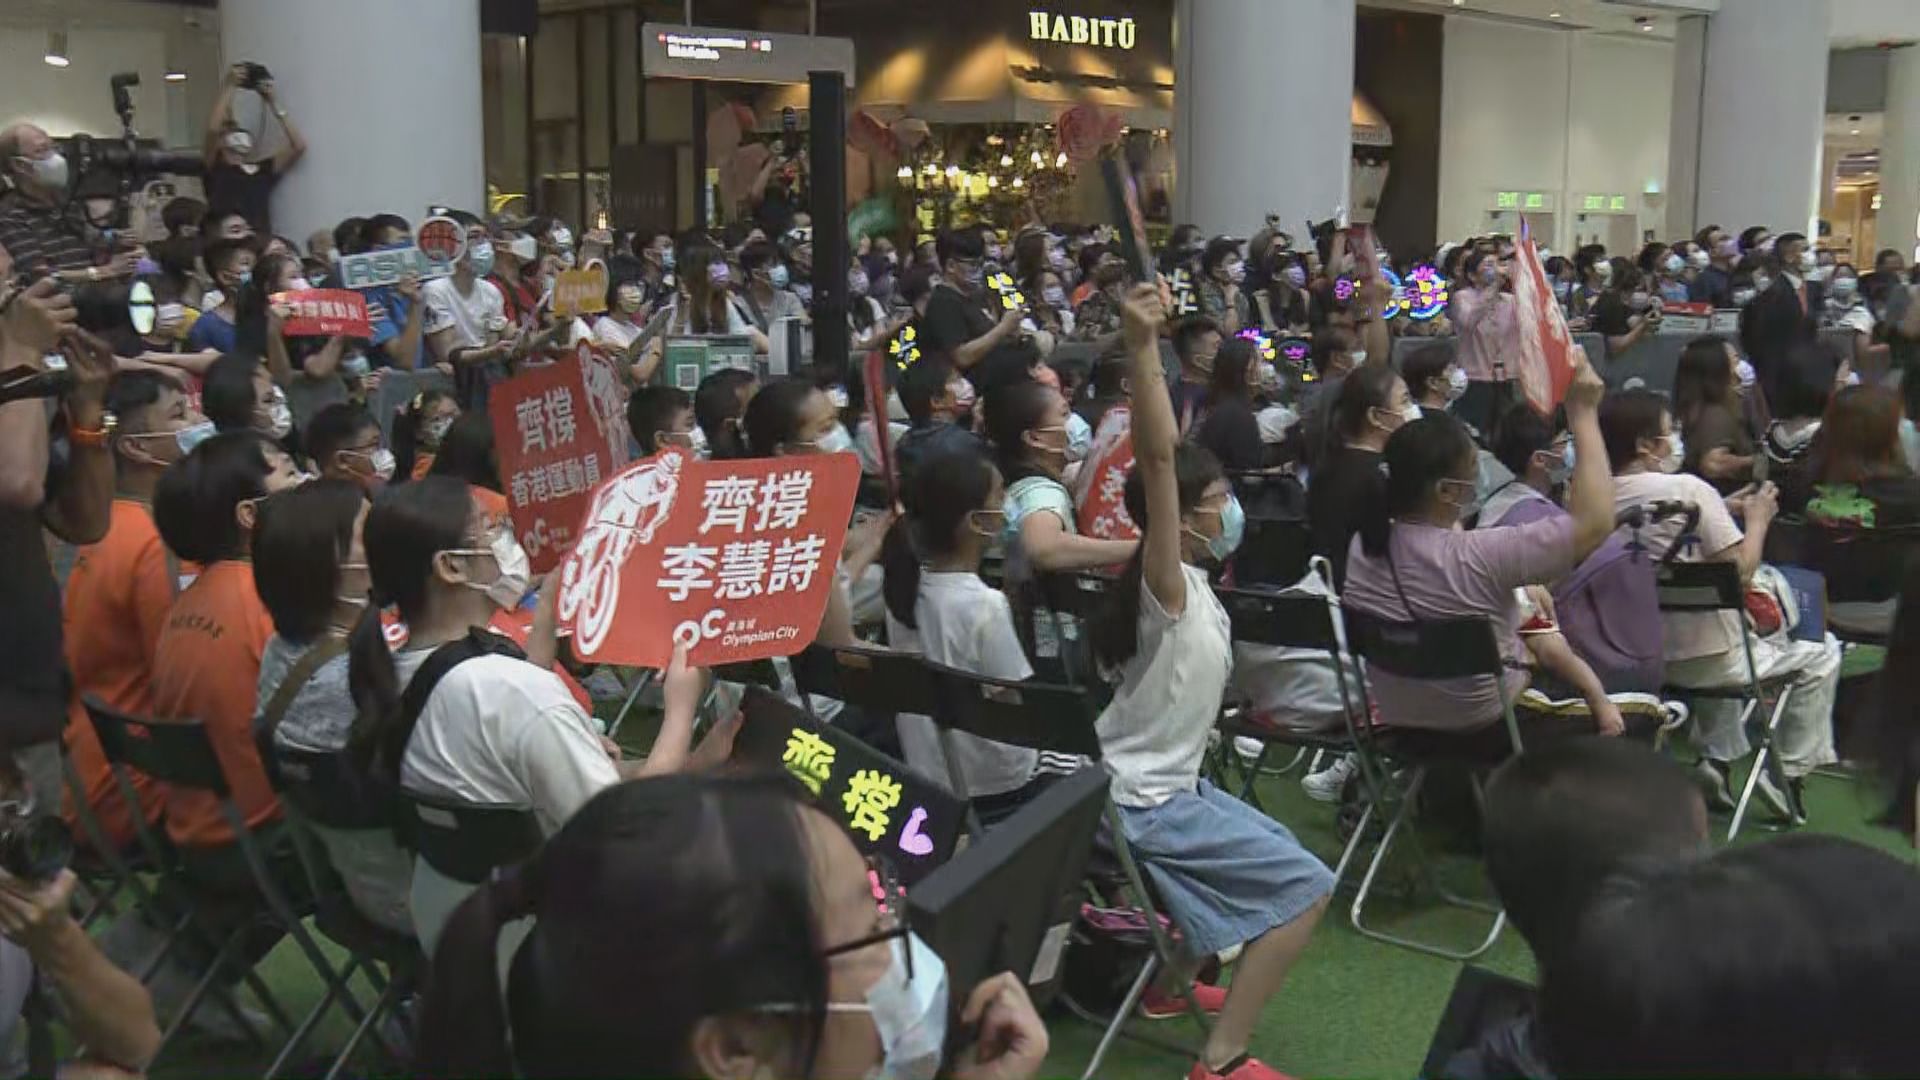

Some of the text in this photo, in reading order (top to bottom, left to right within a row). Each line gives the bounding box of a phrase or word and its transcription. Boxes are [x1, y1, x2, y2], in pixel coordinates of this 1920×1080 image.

[515, 386, 577, 454] 齊撐
[511, 452, 601, 509] 香港運動員
[698, 470, 813, 534] 齊撐
[656, 534, 827, 602] 李慧詩
[722, 630, 775, 647] Olympian
[775, 625, 800, 640] City
